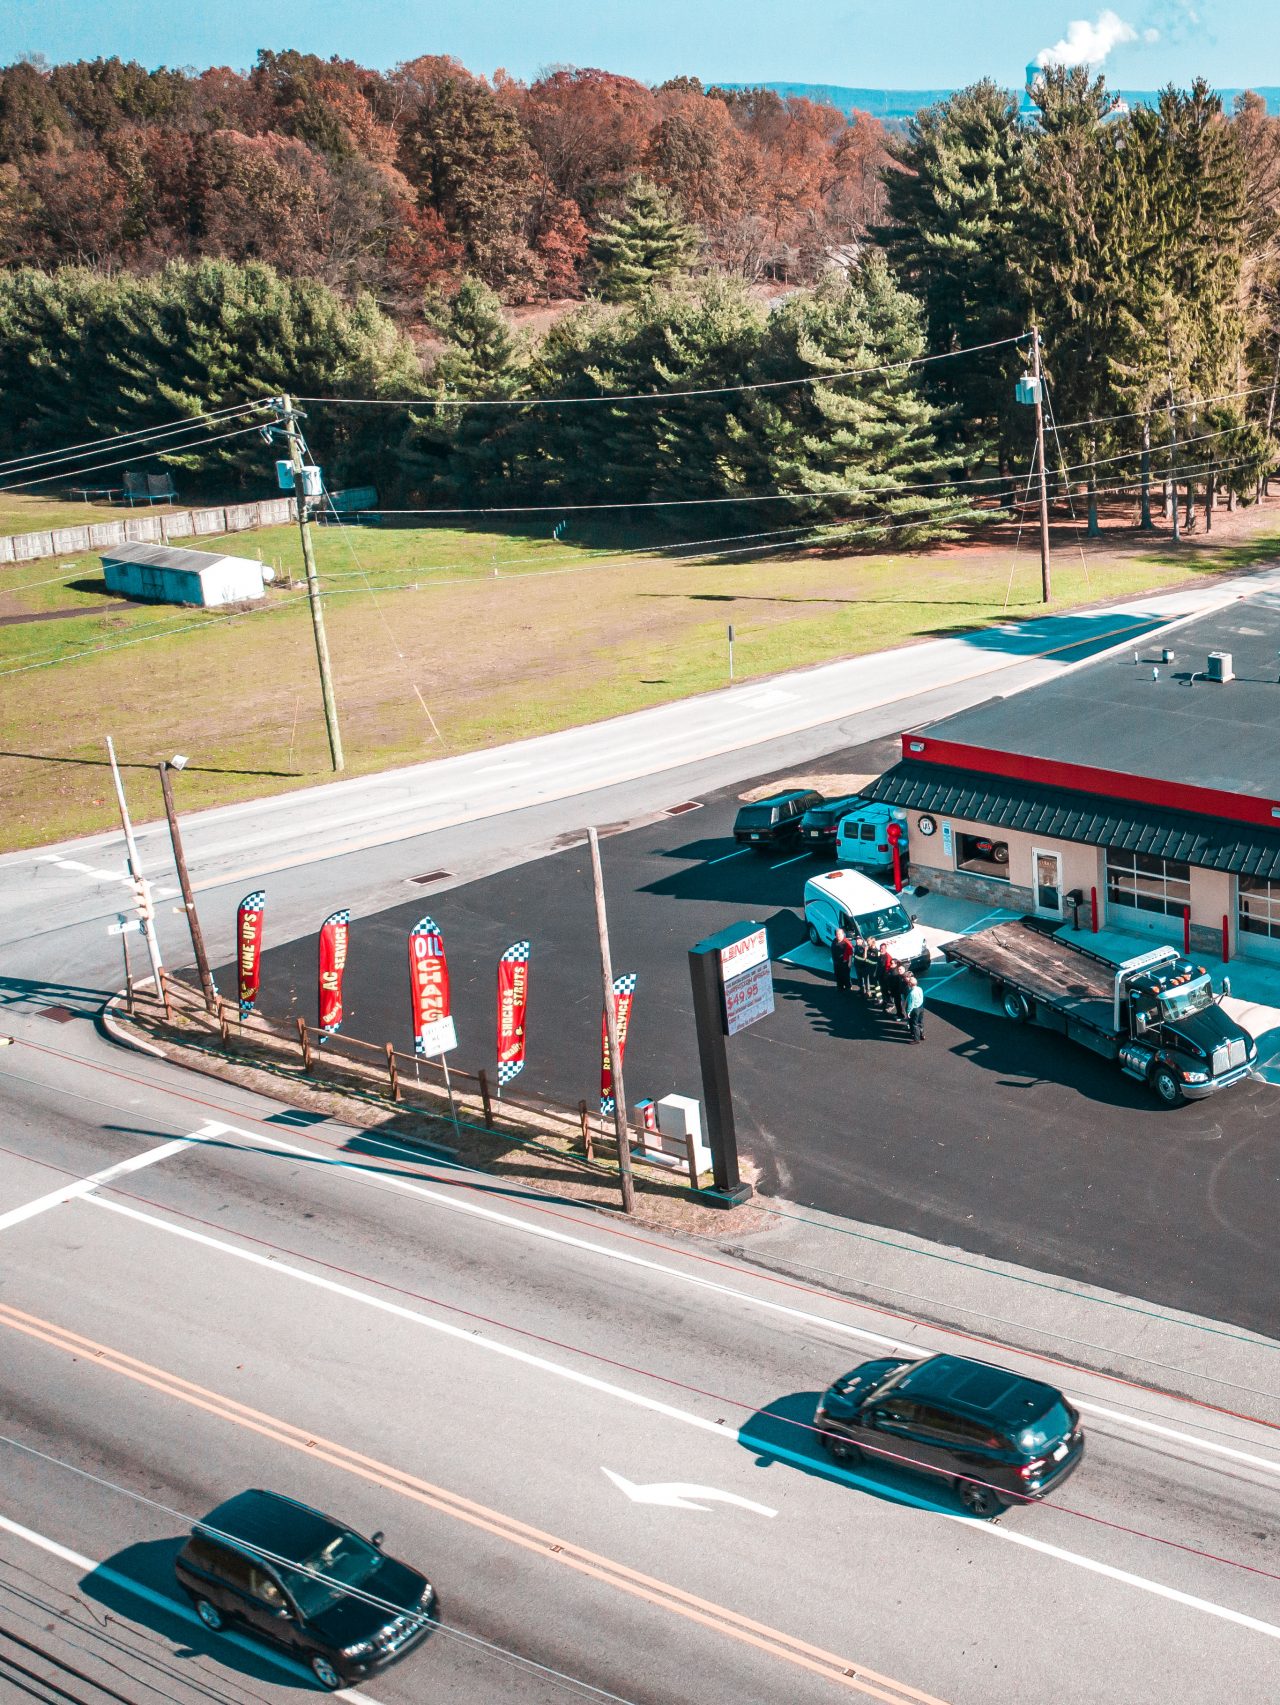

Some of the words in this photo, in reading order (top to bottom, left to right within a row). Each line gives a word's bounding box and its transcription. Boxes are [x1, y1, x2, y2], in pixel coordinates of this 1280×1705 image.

[242, 913, 257, 976] TUNE-UPS
[335, 926, 346, 969] SERVICE
[415, 937, 443, 957] OIL
[722, 931, 765, 961] LENNY'S
[323, 971, 338, 991] AC
[418, 959, 444, 1021] CHANG
[514, 966, 525, 1006] STRUTS
[727, 984, 758, 1010] $49.95
[617, 998, 629, 1042] SERVICE
